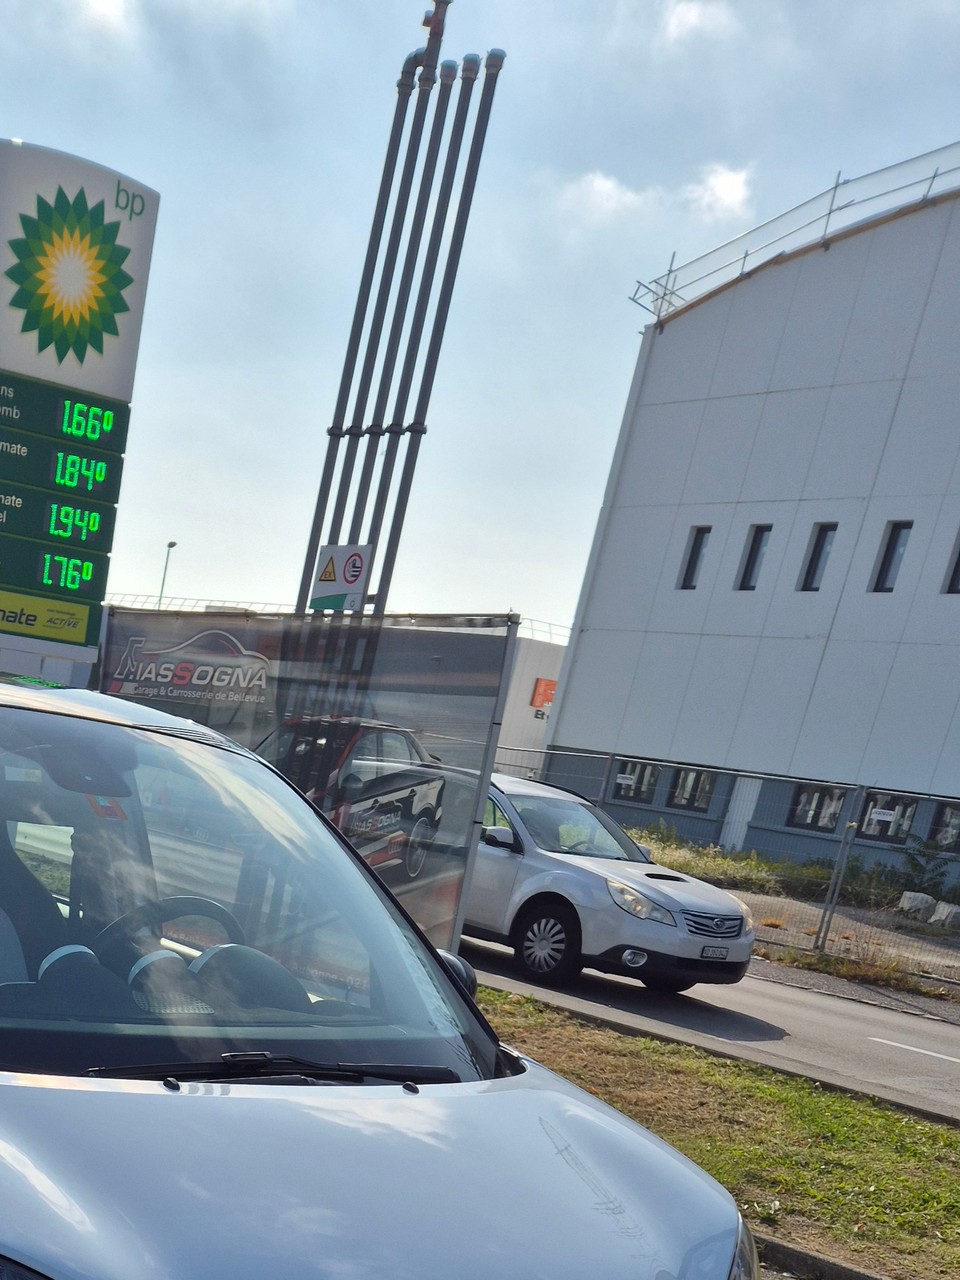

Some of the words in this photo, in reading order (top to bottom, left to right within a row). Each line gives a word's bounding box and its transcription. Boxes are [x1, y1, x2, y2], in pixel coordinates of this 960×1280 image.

[115, 180, 145, 220] bp
[46, 617, 81, 629] ACTIVE
[167, 686, 214, 700] Carrosserie
[215, 690, 227, 700] de
[228, 691, 266, 703] Bellevue
